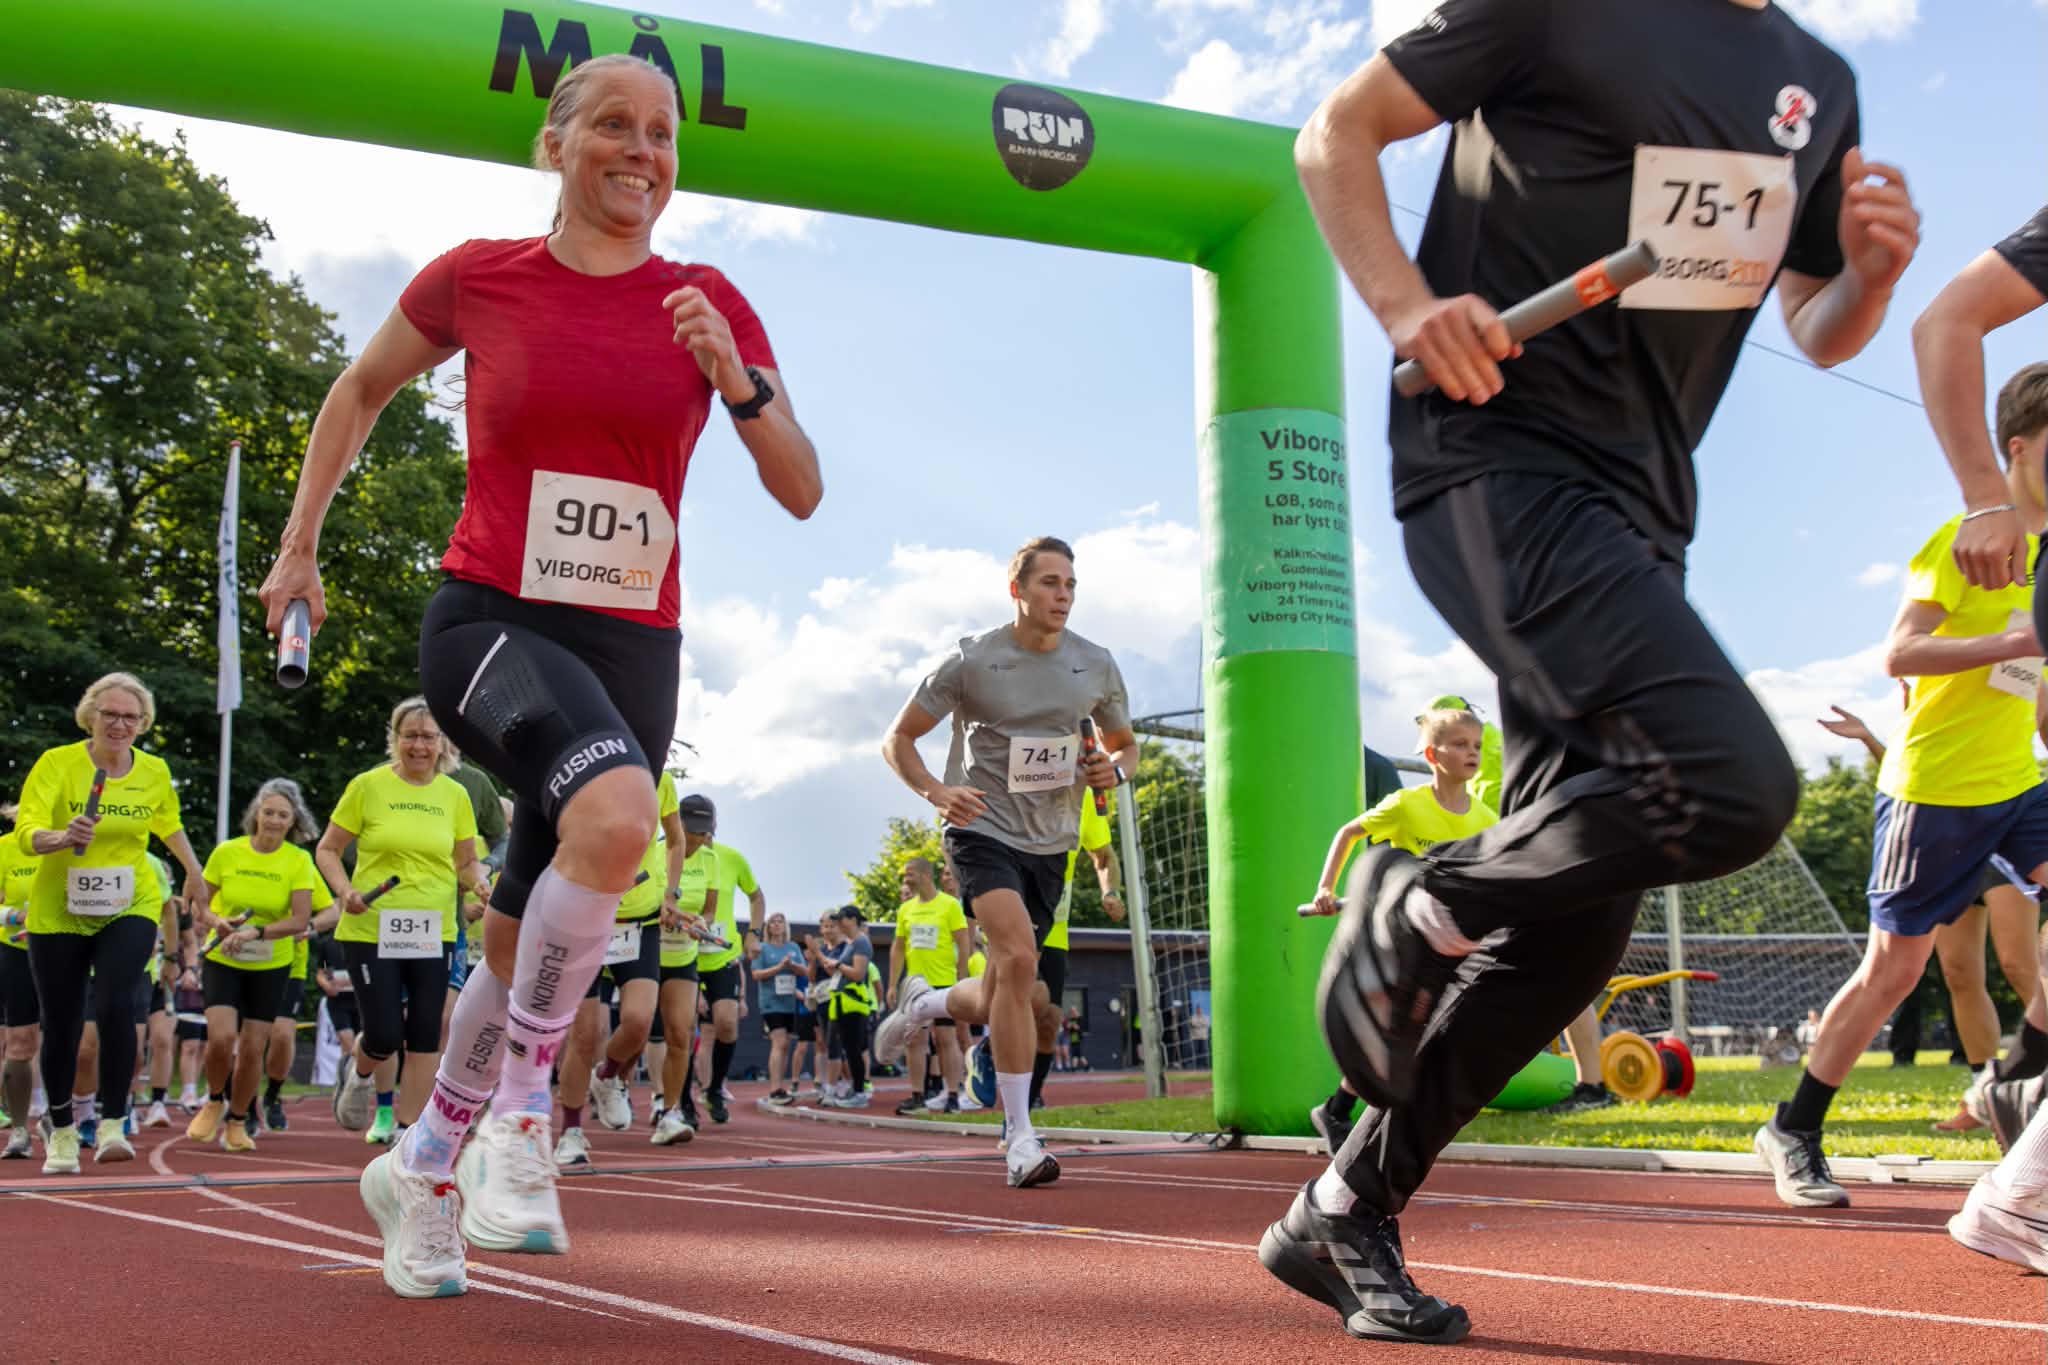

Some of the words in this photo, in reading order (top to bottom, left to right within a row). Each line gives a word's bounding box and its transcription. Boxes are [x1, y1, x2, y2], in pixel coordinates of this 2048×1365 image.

[488, 8, 748, 130] MÅL
[1003, 107, 1084, 147] RUN
[1662, 180, 1766, 230] 75-1
[1268, 460, 1284, 481] 5
[1309, 497, 1335, 511] som
[554, 498, 649, 546] 90-1
[1272, 512, 1301, 527] har
[1305, 513, 1330, 531] lyst
[1247, 580, 1296, 592] Viborg
[1277, 594, 1294, 607] 24
[1247, 611, 1297, 624] Viborg
[1021, 745, 1068, 765] 74-1
[549, 738, 628, 799] FUSION
[77, 876, 121, 892] 92-1
[389, 918, 430, 934] 93-1
[531, 943, 568, 1012] FUSION
[465, 1022, 504, 1074] FUSION
